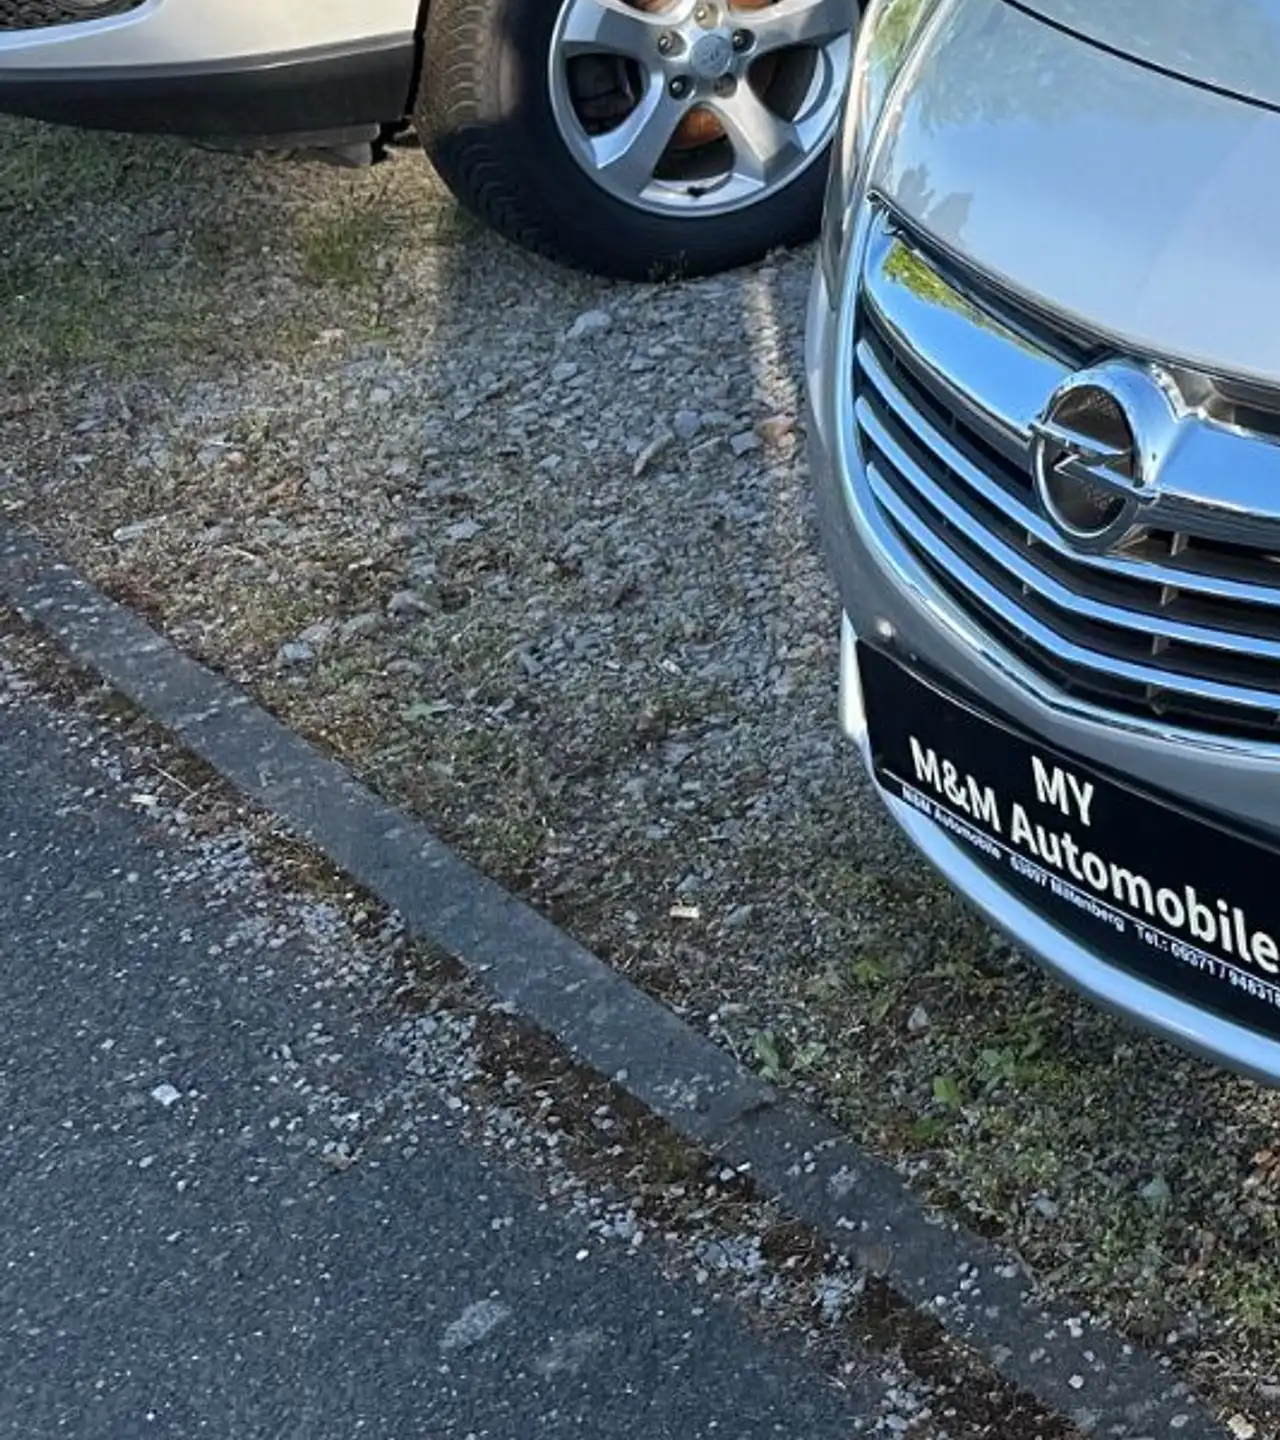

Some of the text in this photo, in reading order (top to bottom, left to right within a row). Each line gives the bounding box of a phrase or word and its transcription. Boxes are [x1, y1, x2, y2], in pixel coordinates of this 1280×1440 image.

[908, 735, 1280, 974] M&M Automobile
[1031, 755, 1094, 827] MY
